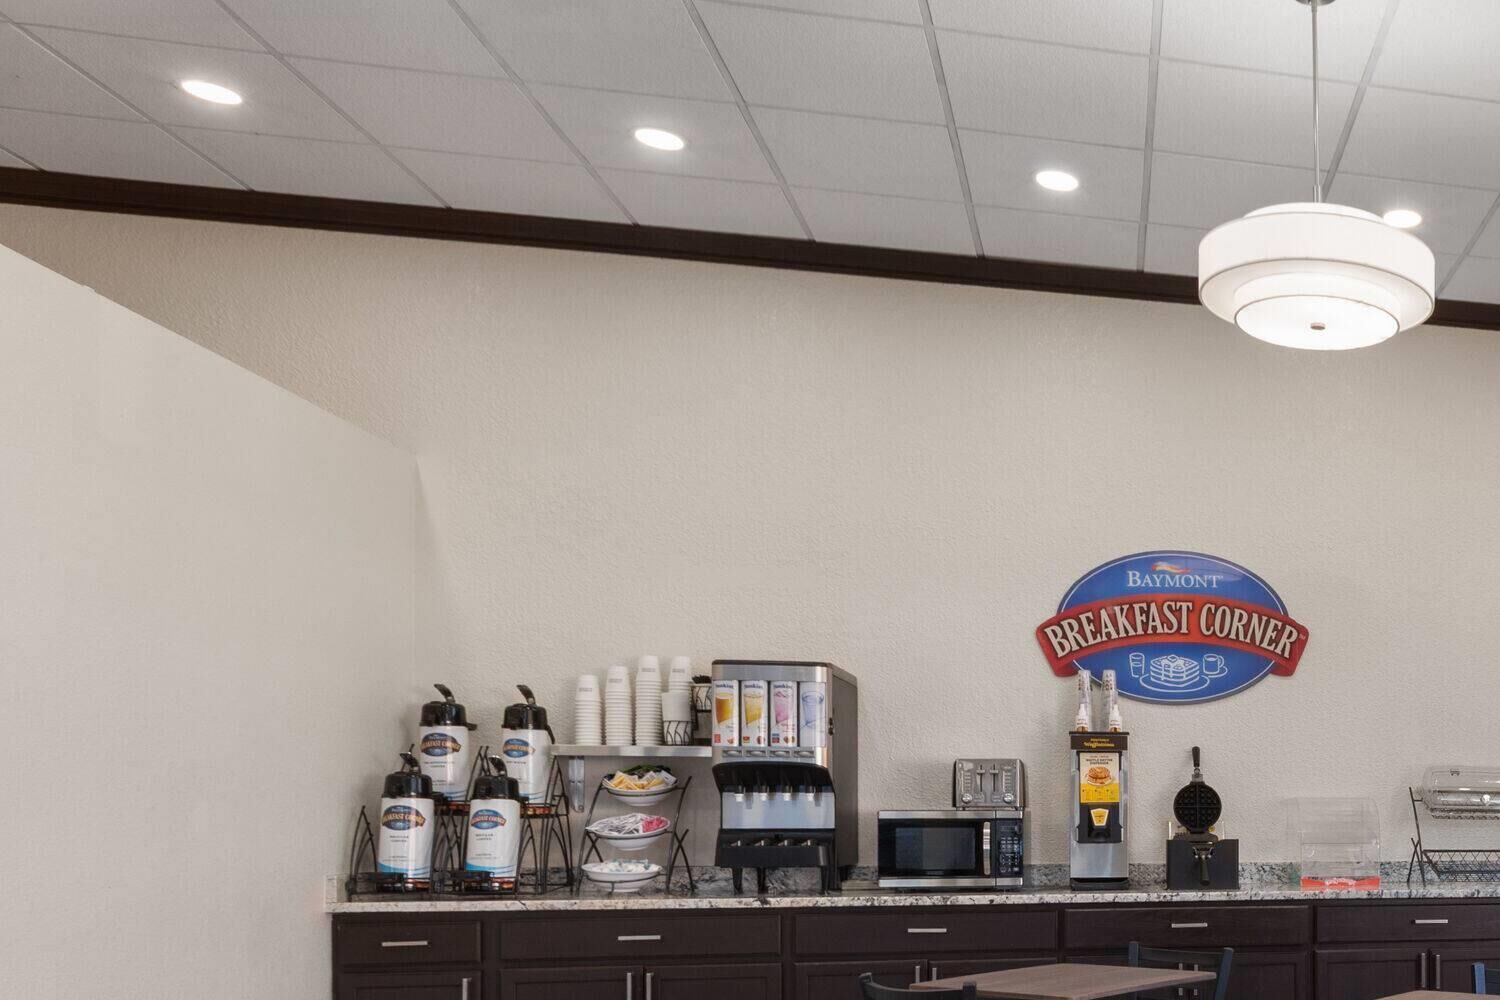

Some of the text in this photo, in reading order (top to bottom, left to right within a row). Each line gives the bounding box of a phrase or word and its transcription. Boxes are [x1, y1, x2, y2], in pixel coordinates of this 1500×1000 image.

[1127, 570, 1220, 588] BAYMONT
[1044, 601, 1299, 659] BREAKFAST CORNER
